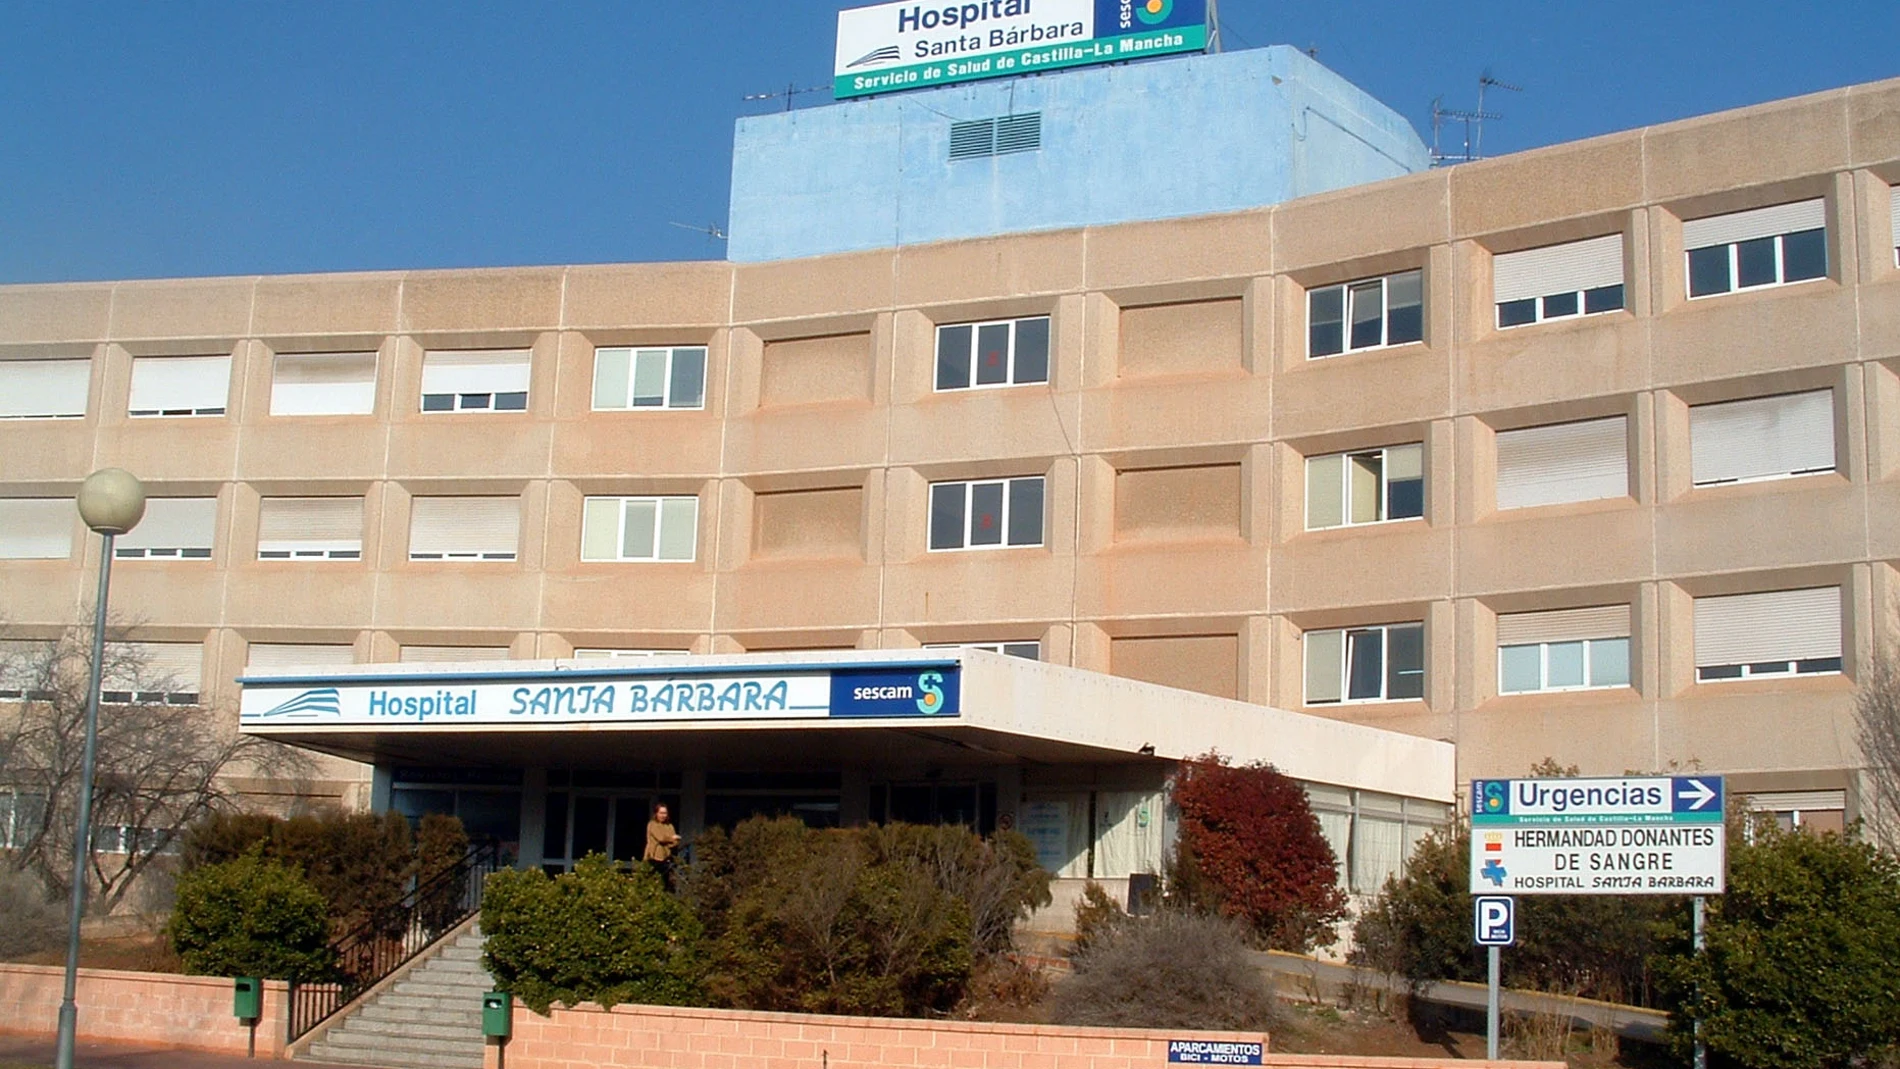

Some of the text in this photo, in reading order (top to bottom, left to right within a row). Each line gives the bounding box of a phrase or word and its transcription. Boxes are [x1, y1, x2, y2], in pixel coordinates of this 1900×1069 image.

[899, 0, 1030, 33] Hospital
[914, 21, 1083, 58] Santa Bárbara
[854, 70, 918, 90] Servicio
[923, 67, 941, 80] de
[947, 60, 990, 76] Salud
[996, 56, 1015, 69] de
[1119, 34, 1183, 53] Mancha
[369, 677, 788, 720] Hospital SANTA BÁRBARA
[853, 684, 912, 700] sescam
[1519, 781, 1662, 811] Urgencias
[1564, 815, 1585, 823] Salud
[1514, 828, 1714, 848] HERMANDAD DONANTES
[1555, 852, 1673, 871] DE SANGRE
[1514, 876, 1714, 888] HOSPITAL SANTA BARBARA
[1481, 901, 1508, 939] P
[1180, 1053, 1200, 1061] BICI
[1211, 1054, 1248, 1063] MOTOS
